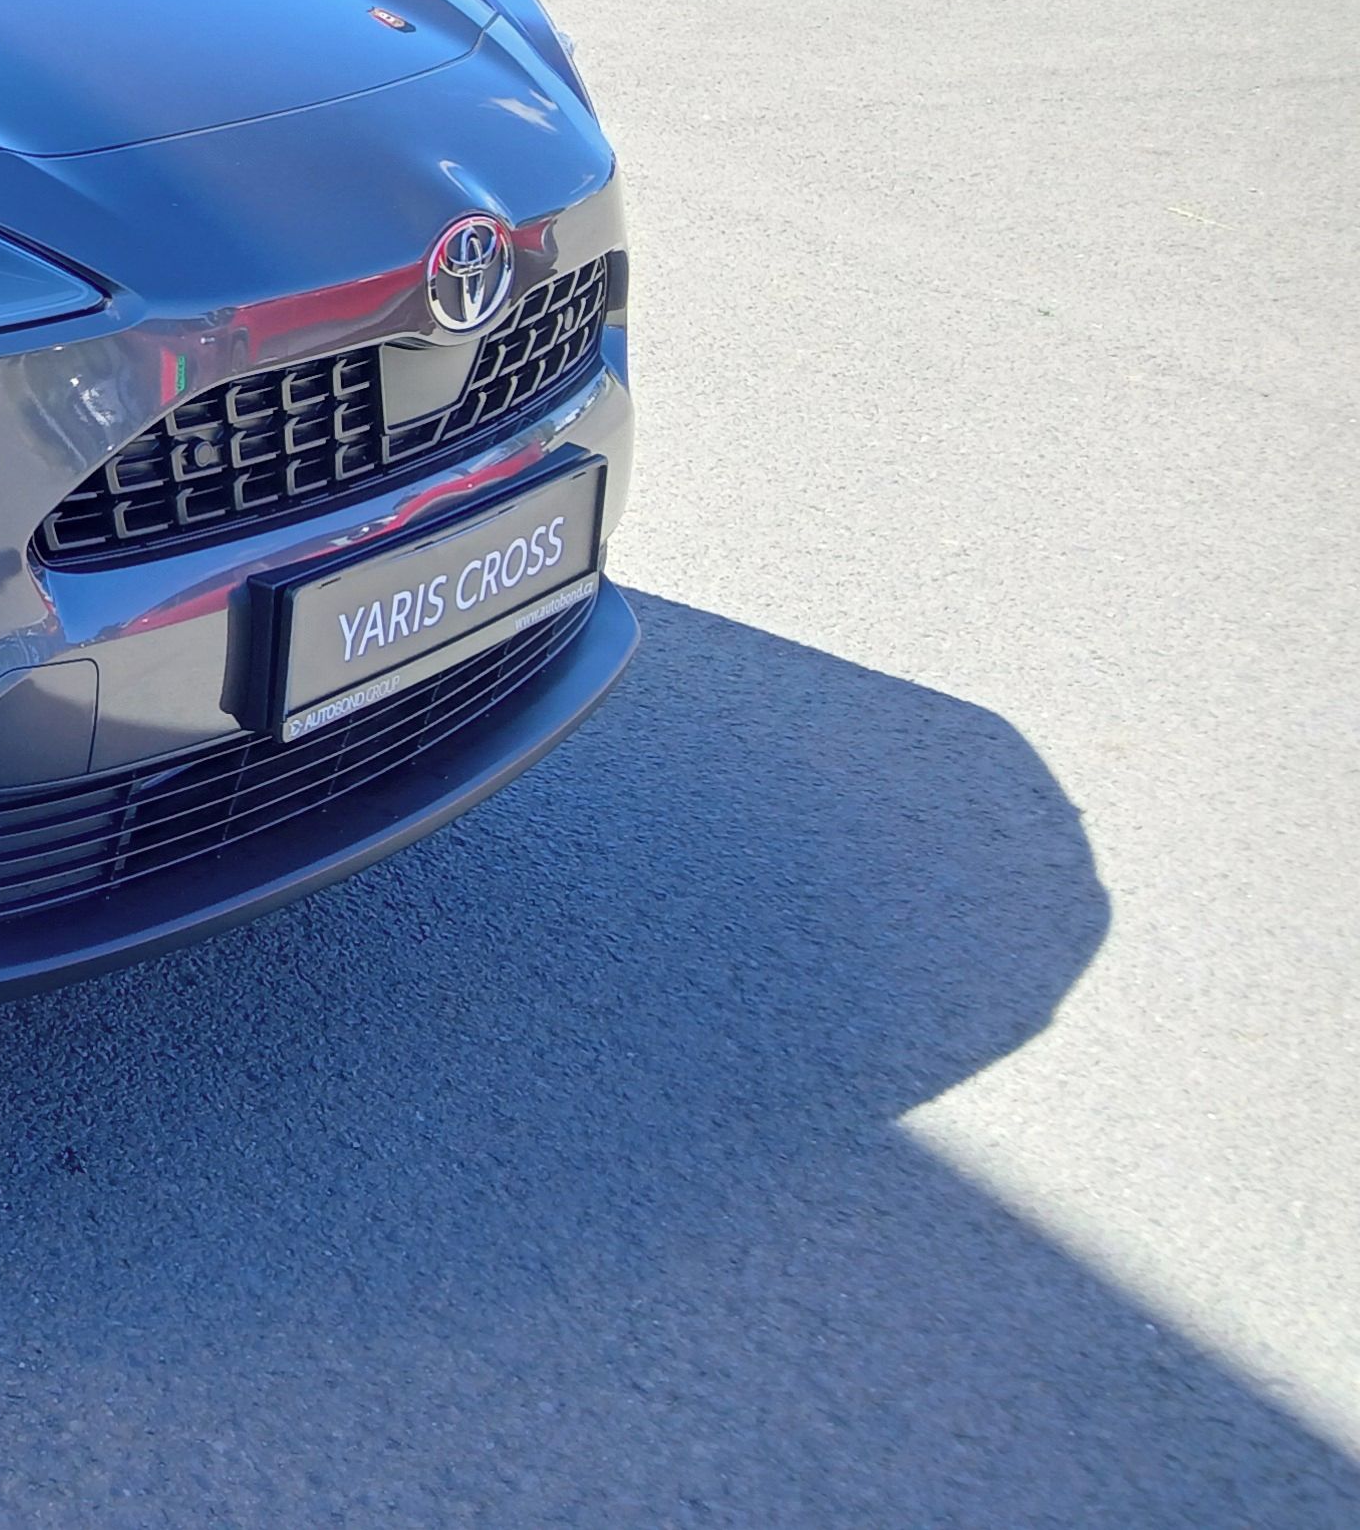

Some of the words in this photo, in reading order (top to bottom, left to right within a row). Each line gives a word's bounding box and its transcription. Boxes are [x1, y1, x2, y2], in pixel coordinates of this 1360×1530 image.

[338, 575, 448, 662] YARIS
[455, 516, 565, 610] CROSS
[514, 581, 594, 631] www.autobond.cz
[304, 691, 365, 730] AUTOBOND
[365, 675, 400, 702] GROUP
